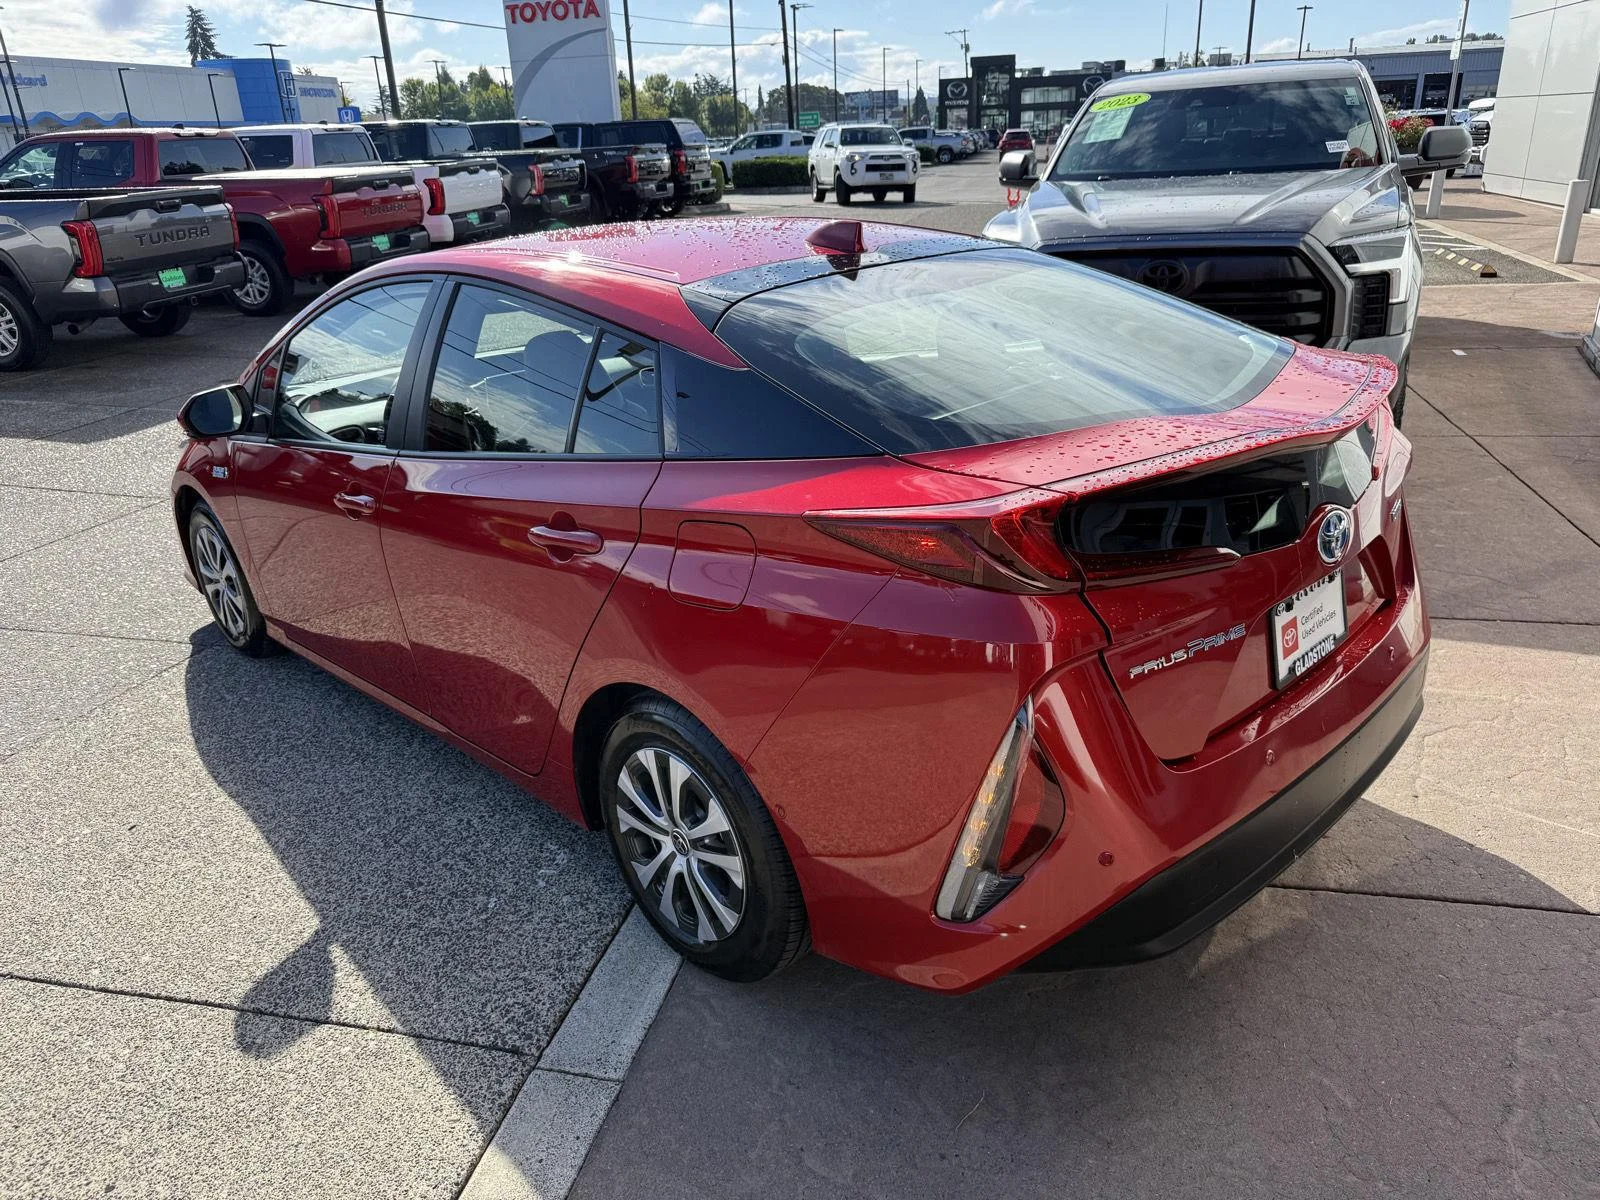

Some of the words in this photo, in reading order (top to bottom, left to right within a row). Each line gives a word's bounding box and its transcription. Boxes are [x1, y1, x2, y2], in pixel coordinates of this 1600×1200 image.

[505, 0, 601, 24] TOYOTA
[299, 87, 338, 98] HONDA
[1097, 95, 1142, 111] 2023
[134, 226, 211, 248] TUNDRA
[1301, 602, 1324, 626] Certified
[1301, 624, 1316, 640] Used
[1315, 608, 1337, 630] Vehicles
[1129, 648, 1187, 679] PRIUS
[1186, 622, 1246, 658] PRIME
[1294, 635, 1337, 677] GLADSTONE
